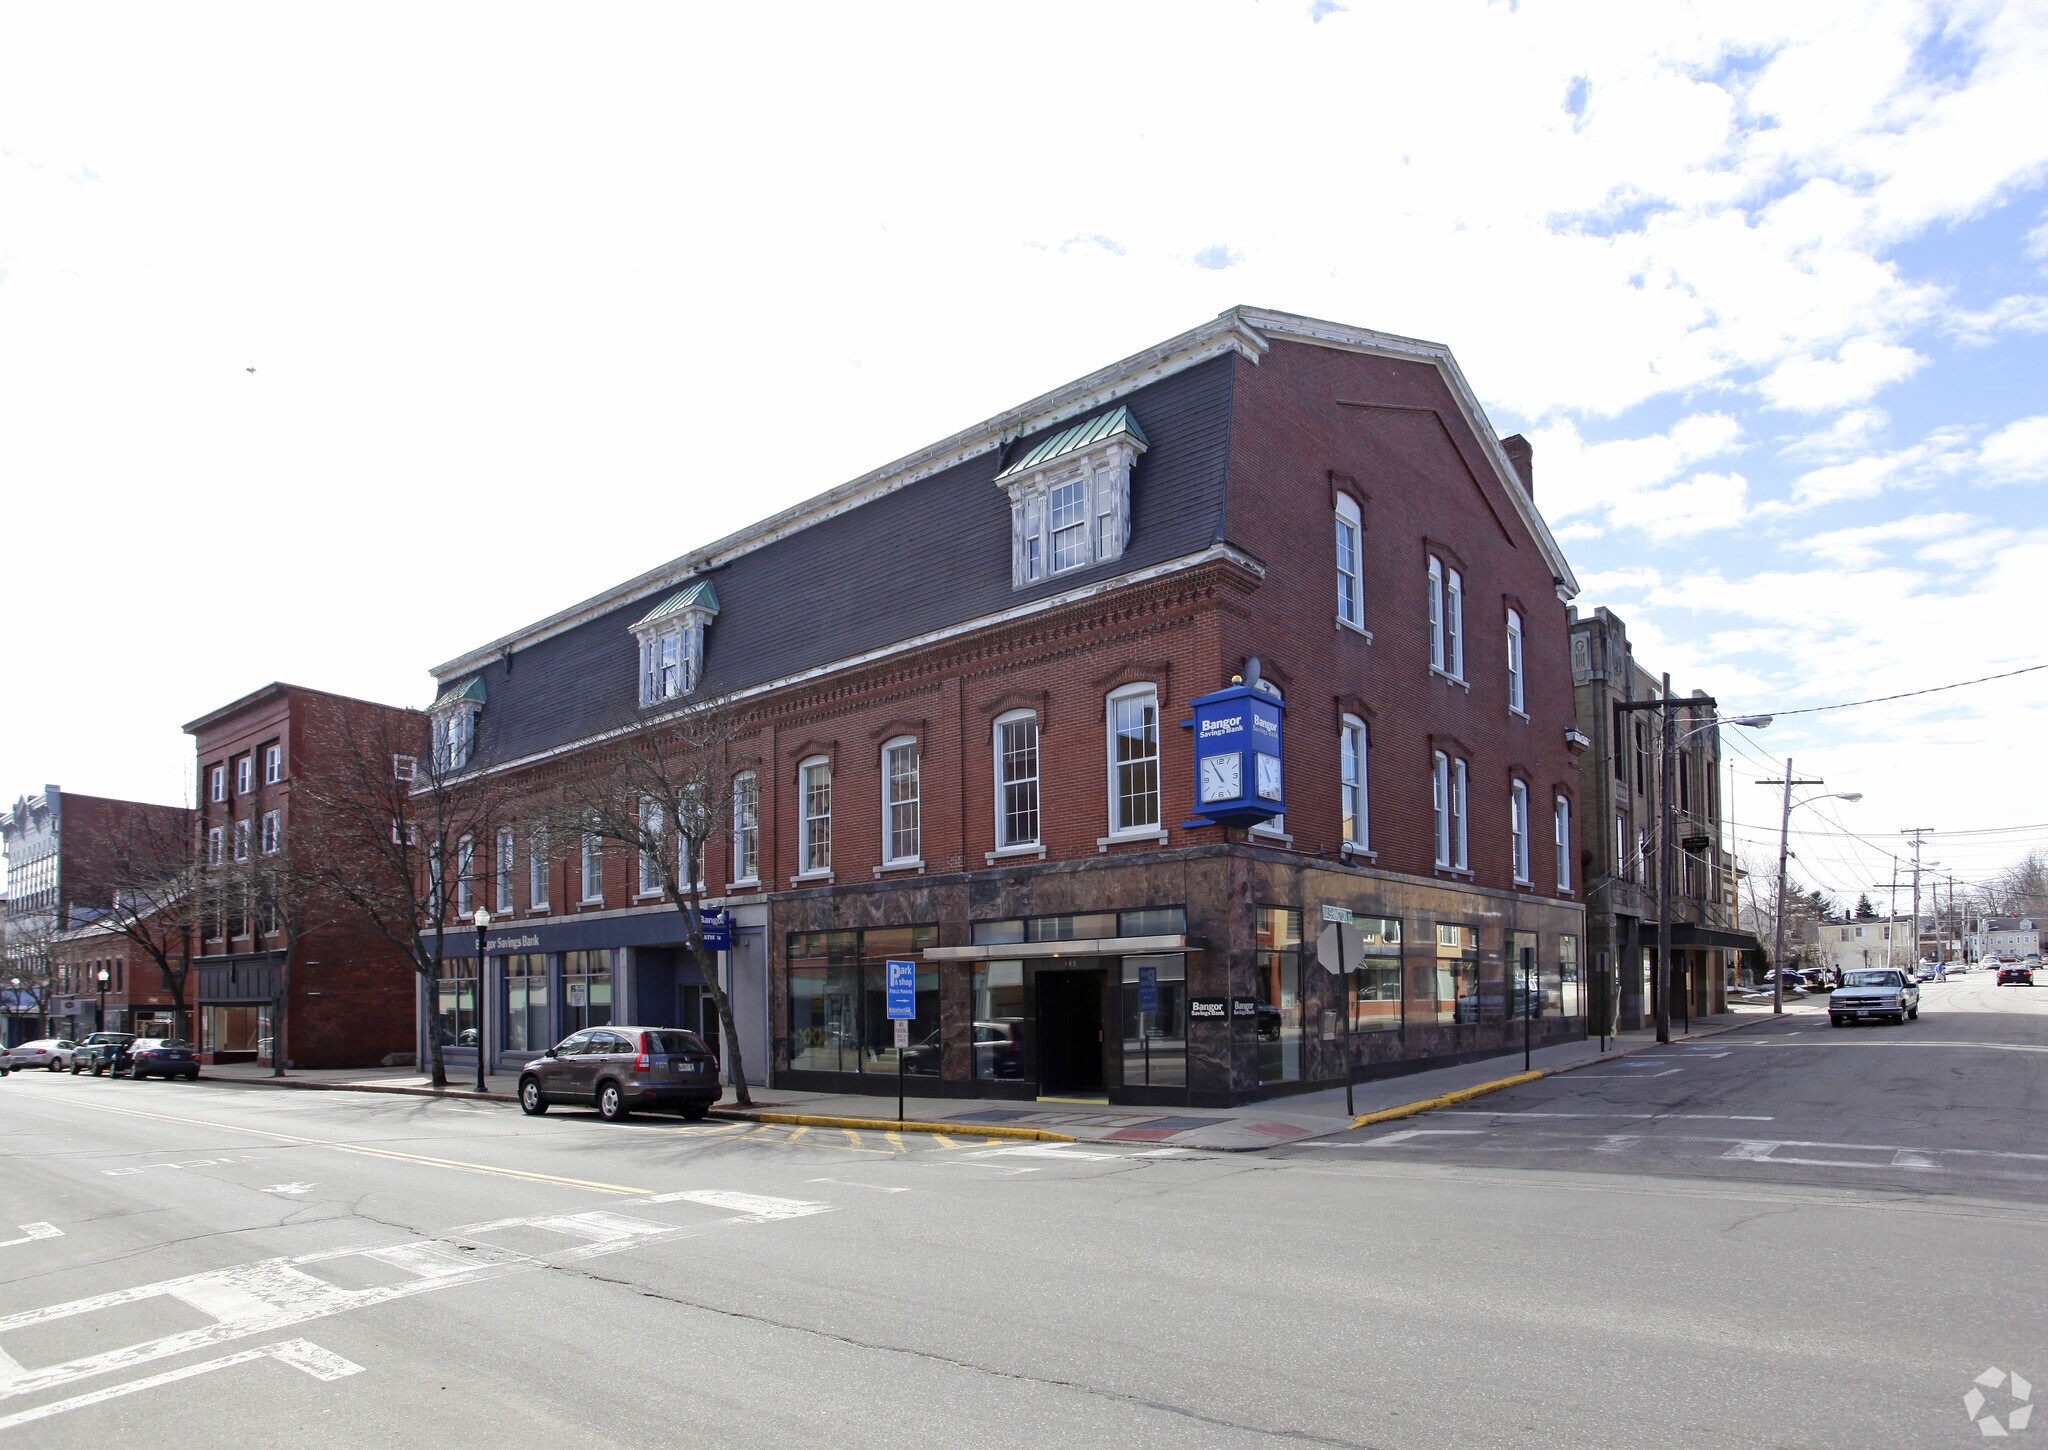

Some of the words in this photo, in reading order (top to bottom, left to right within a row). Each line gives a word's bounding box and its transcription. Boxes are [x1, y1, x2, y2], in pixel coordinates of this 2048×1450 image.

[1202, 716, 1241, 731] Bangor
[1254, 714, 1277, 731] Bangor
[1200, 729, 1225, 738] Savings
[1226, 725, 1243, 734] Bank
[1253, 726, 1267, 736] Savings
[497, 937, 521, 949] Savings
[522, 934, 539, 947] Bank
[890, 964, 912, 987] Park
[899, 978, 912, 987] shop
[1193, 1002, 1223, 1012] Bangor
[1235, 1001, 1254, 1011] Bangor
